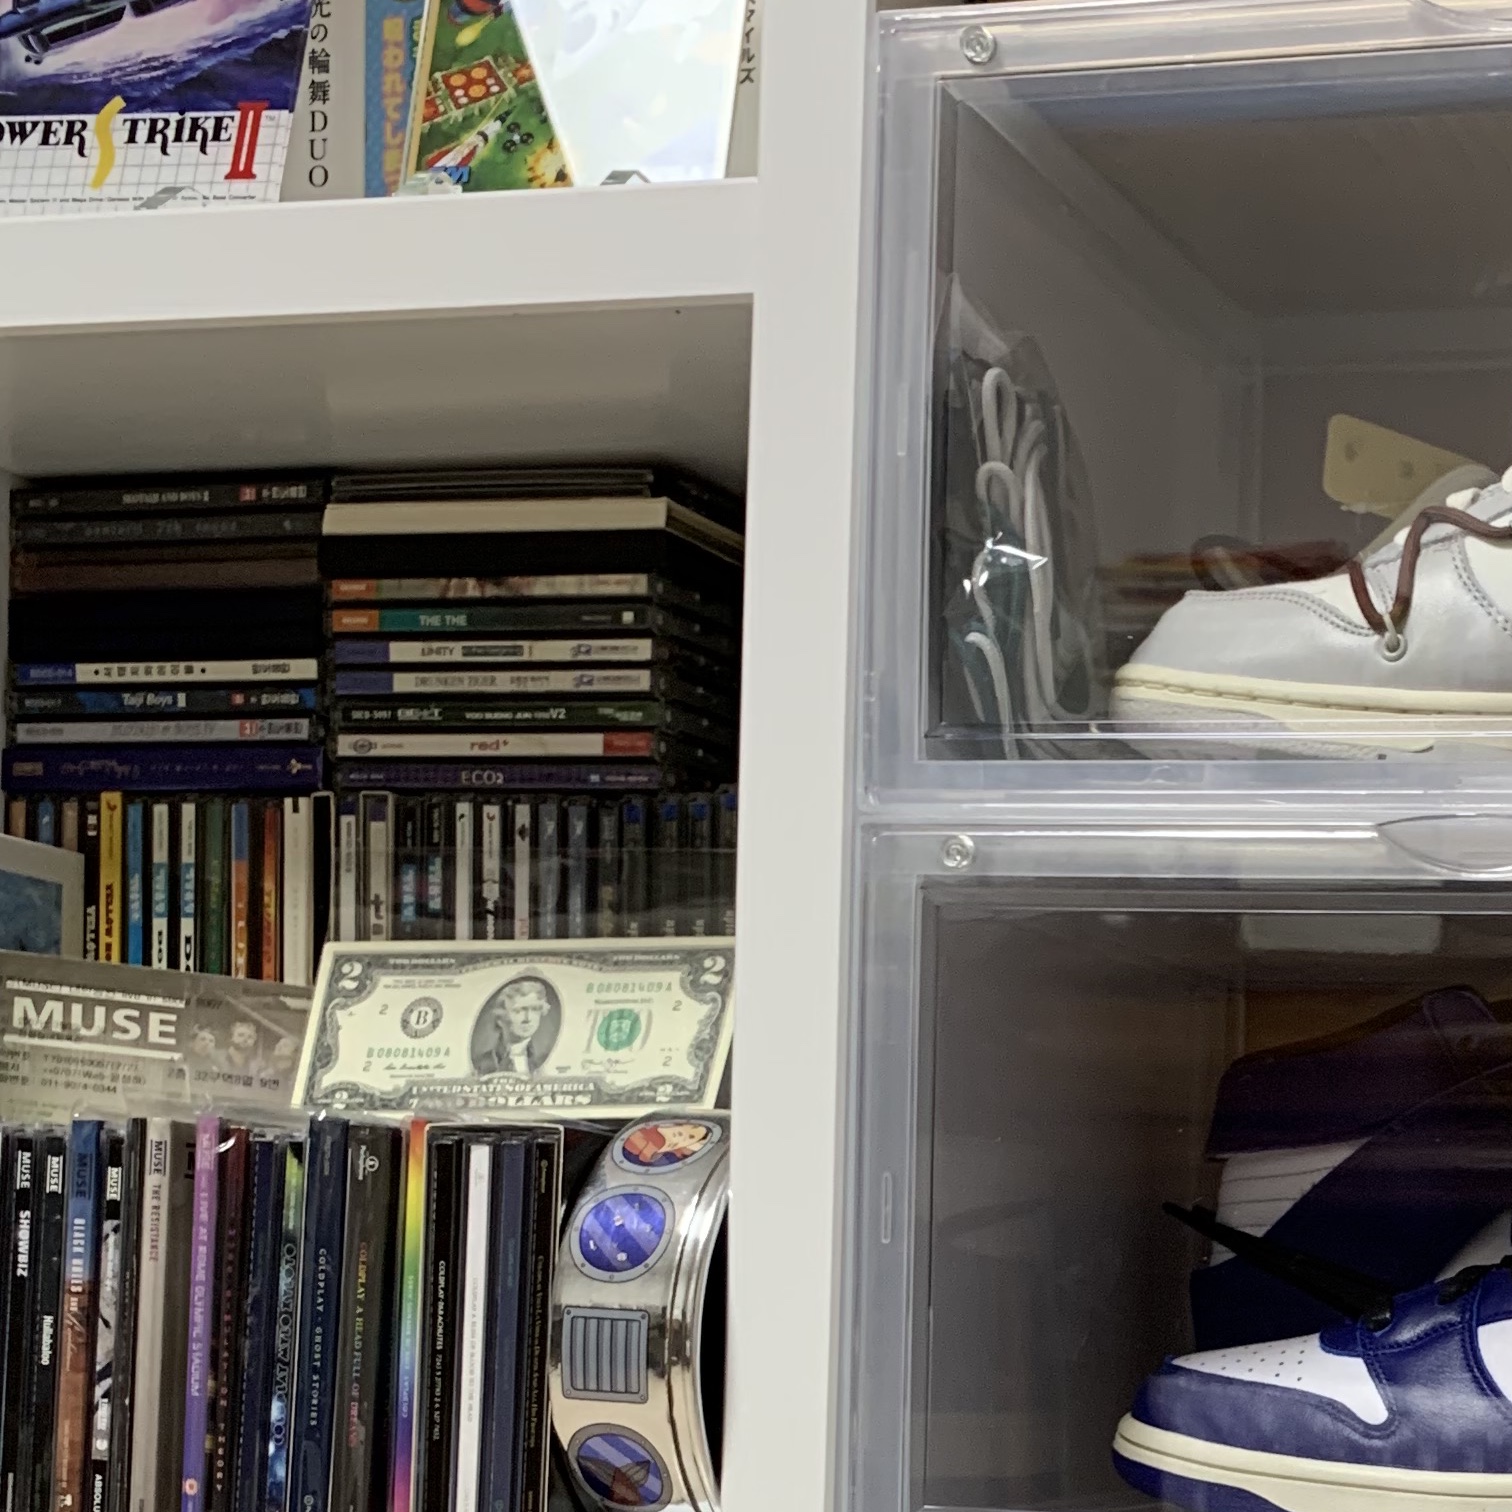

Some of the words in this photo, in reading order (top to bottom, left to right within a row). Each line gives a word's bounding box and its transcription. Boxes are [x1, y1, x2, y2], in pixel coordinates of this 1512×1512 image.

[0, 119, 87, 158] WER
[337, 960, 363, 990] 2
[702, 955, 726, 984] 2
[12, 996, 177, 1045] MUSE
[379, 1003, 388, 1015] 2
[413, 1010, 429, 1025] B
[20, 1151, 31, 1189] MUSE
[49, 1157, 59, 1191] MUSE
[75, 1153, 89, 1198] MUSE
[153, 1141, 163, 1175] MUSE
[109, 1167, 119, 1200] MUSE
[16, 1210, 31, 1277] SHOWBIZ
[316, 1248, 327, 1312] COLDPLAY
[41, 1315, 54, 1365] Hullabaloo
